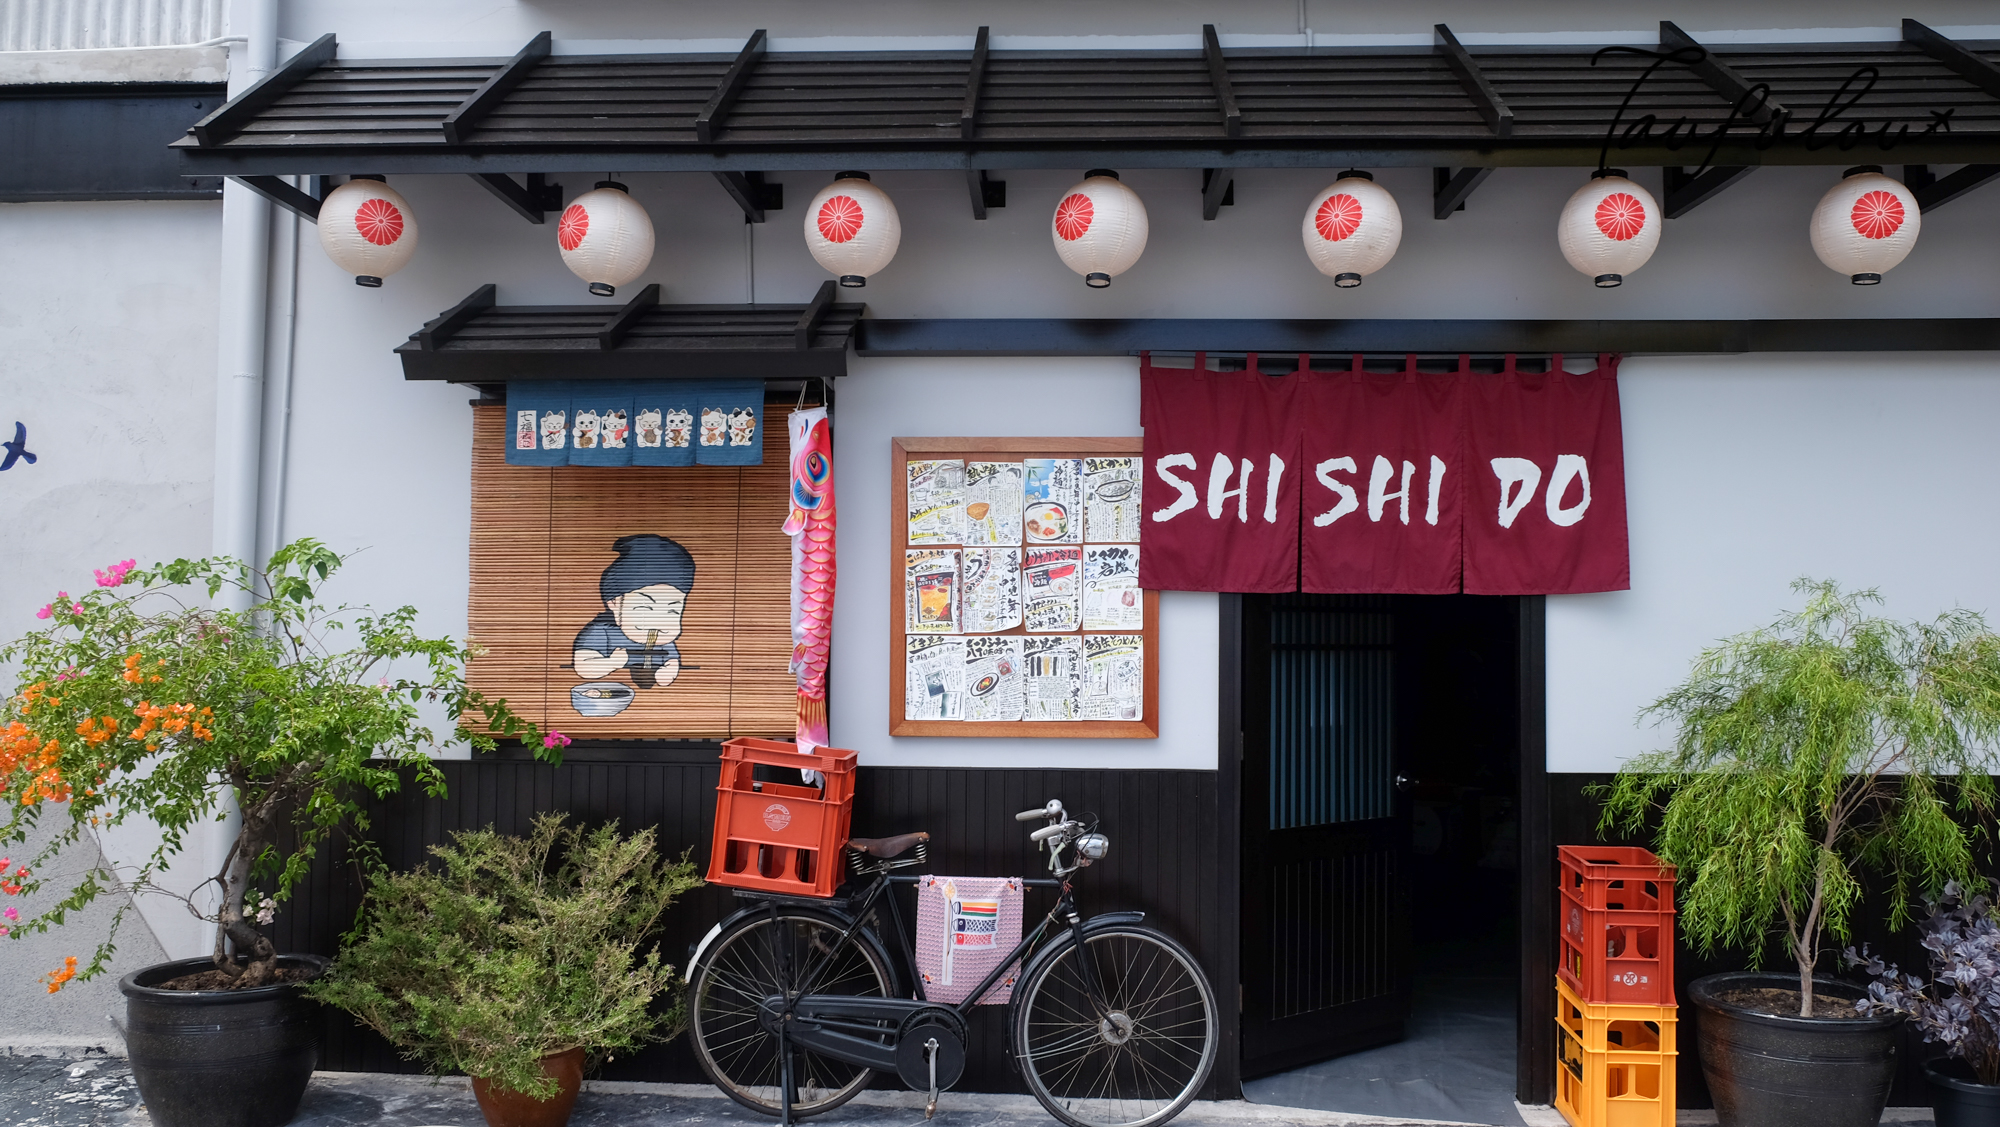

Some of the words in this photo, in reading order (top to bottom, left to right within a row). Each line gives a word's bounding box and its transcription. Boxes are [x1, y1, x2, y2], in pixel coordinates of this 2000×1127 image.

[1152, 452, 1285, 524] SHI
[1314, 454, 1446, 528] SHI
[1490, 453, 1592, 529] DO
